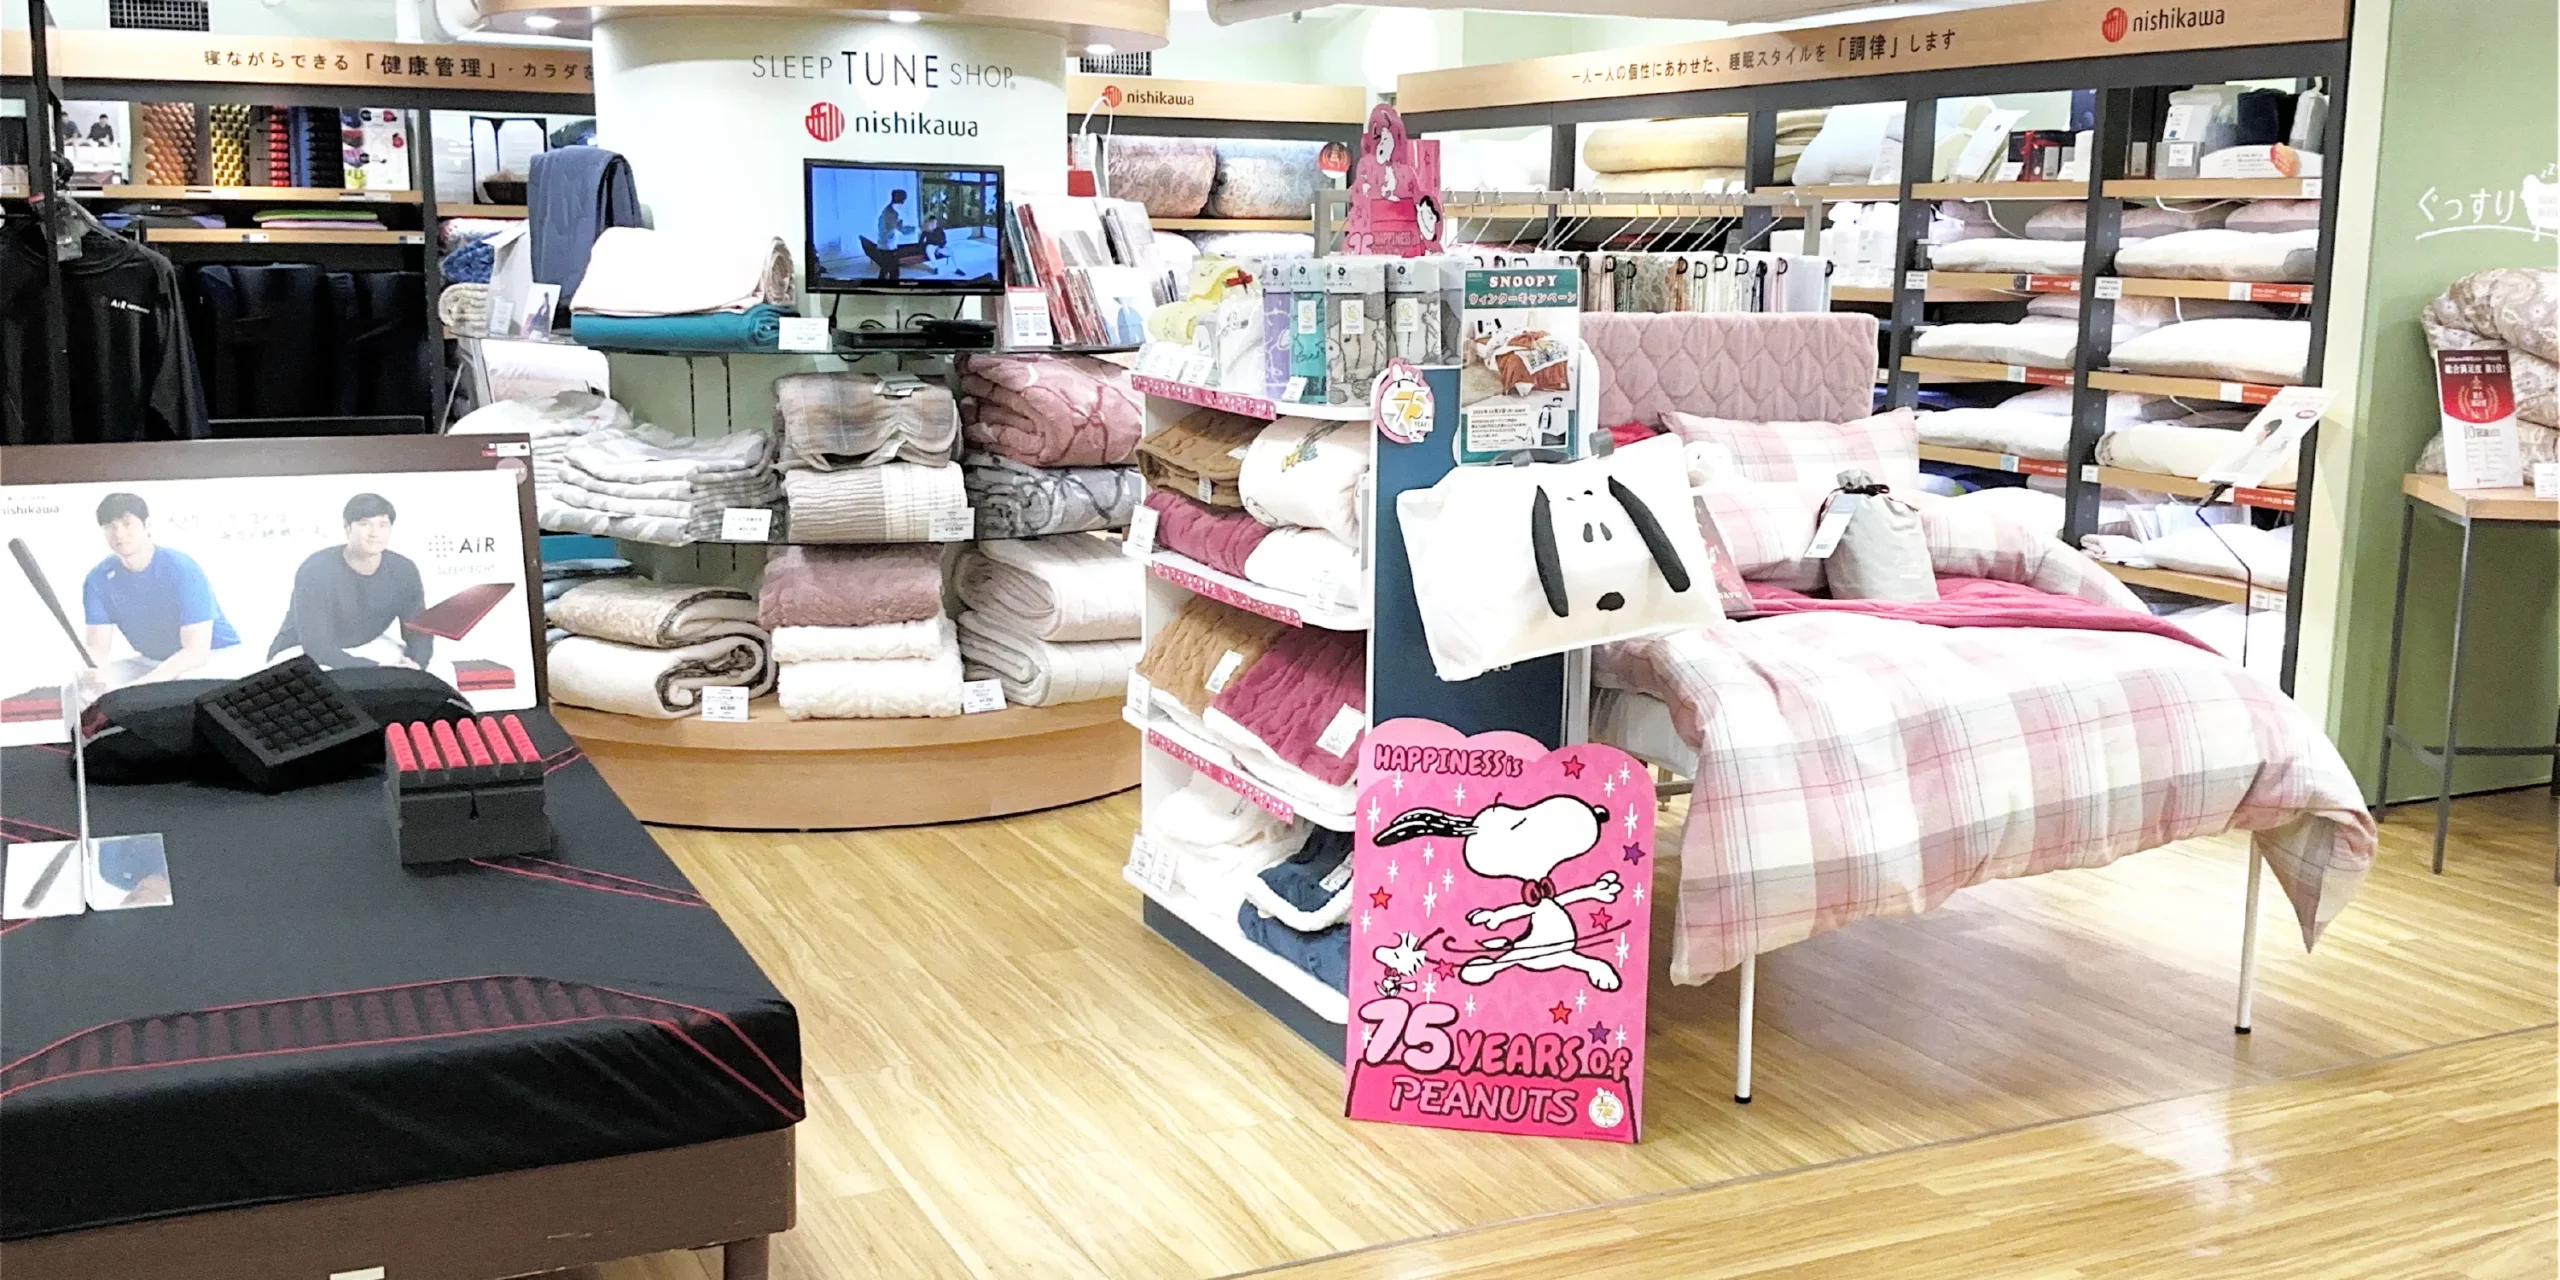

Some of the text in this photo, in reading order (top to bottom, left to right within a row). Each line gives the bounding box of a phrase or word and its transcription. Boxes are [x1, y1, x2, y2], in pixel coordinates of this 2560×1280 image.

[2133, 7, 2225, 32] nishikawa
[752, 55, 833, 79] SLEEP
[841, 51, 938, 88] TUNE
[1127, 91, 1194, 106] nishikawa
[855, 111, 978, 137] nishikawa
[2418, 186, 2515, 223] ぐっすり
[1489, 275, 1557, 288] SNOOPY
[1468, 292, 1576, 305] ウィンターキャンペーン
[1374, 744, 1523, 777] HAPPINESS is
[1358, 997, 1459, 1072] 75
[1456, 1029, 1584, 1078] YEARS
[1391, 1075, 1578, 1125] PEANUTS
